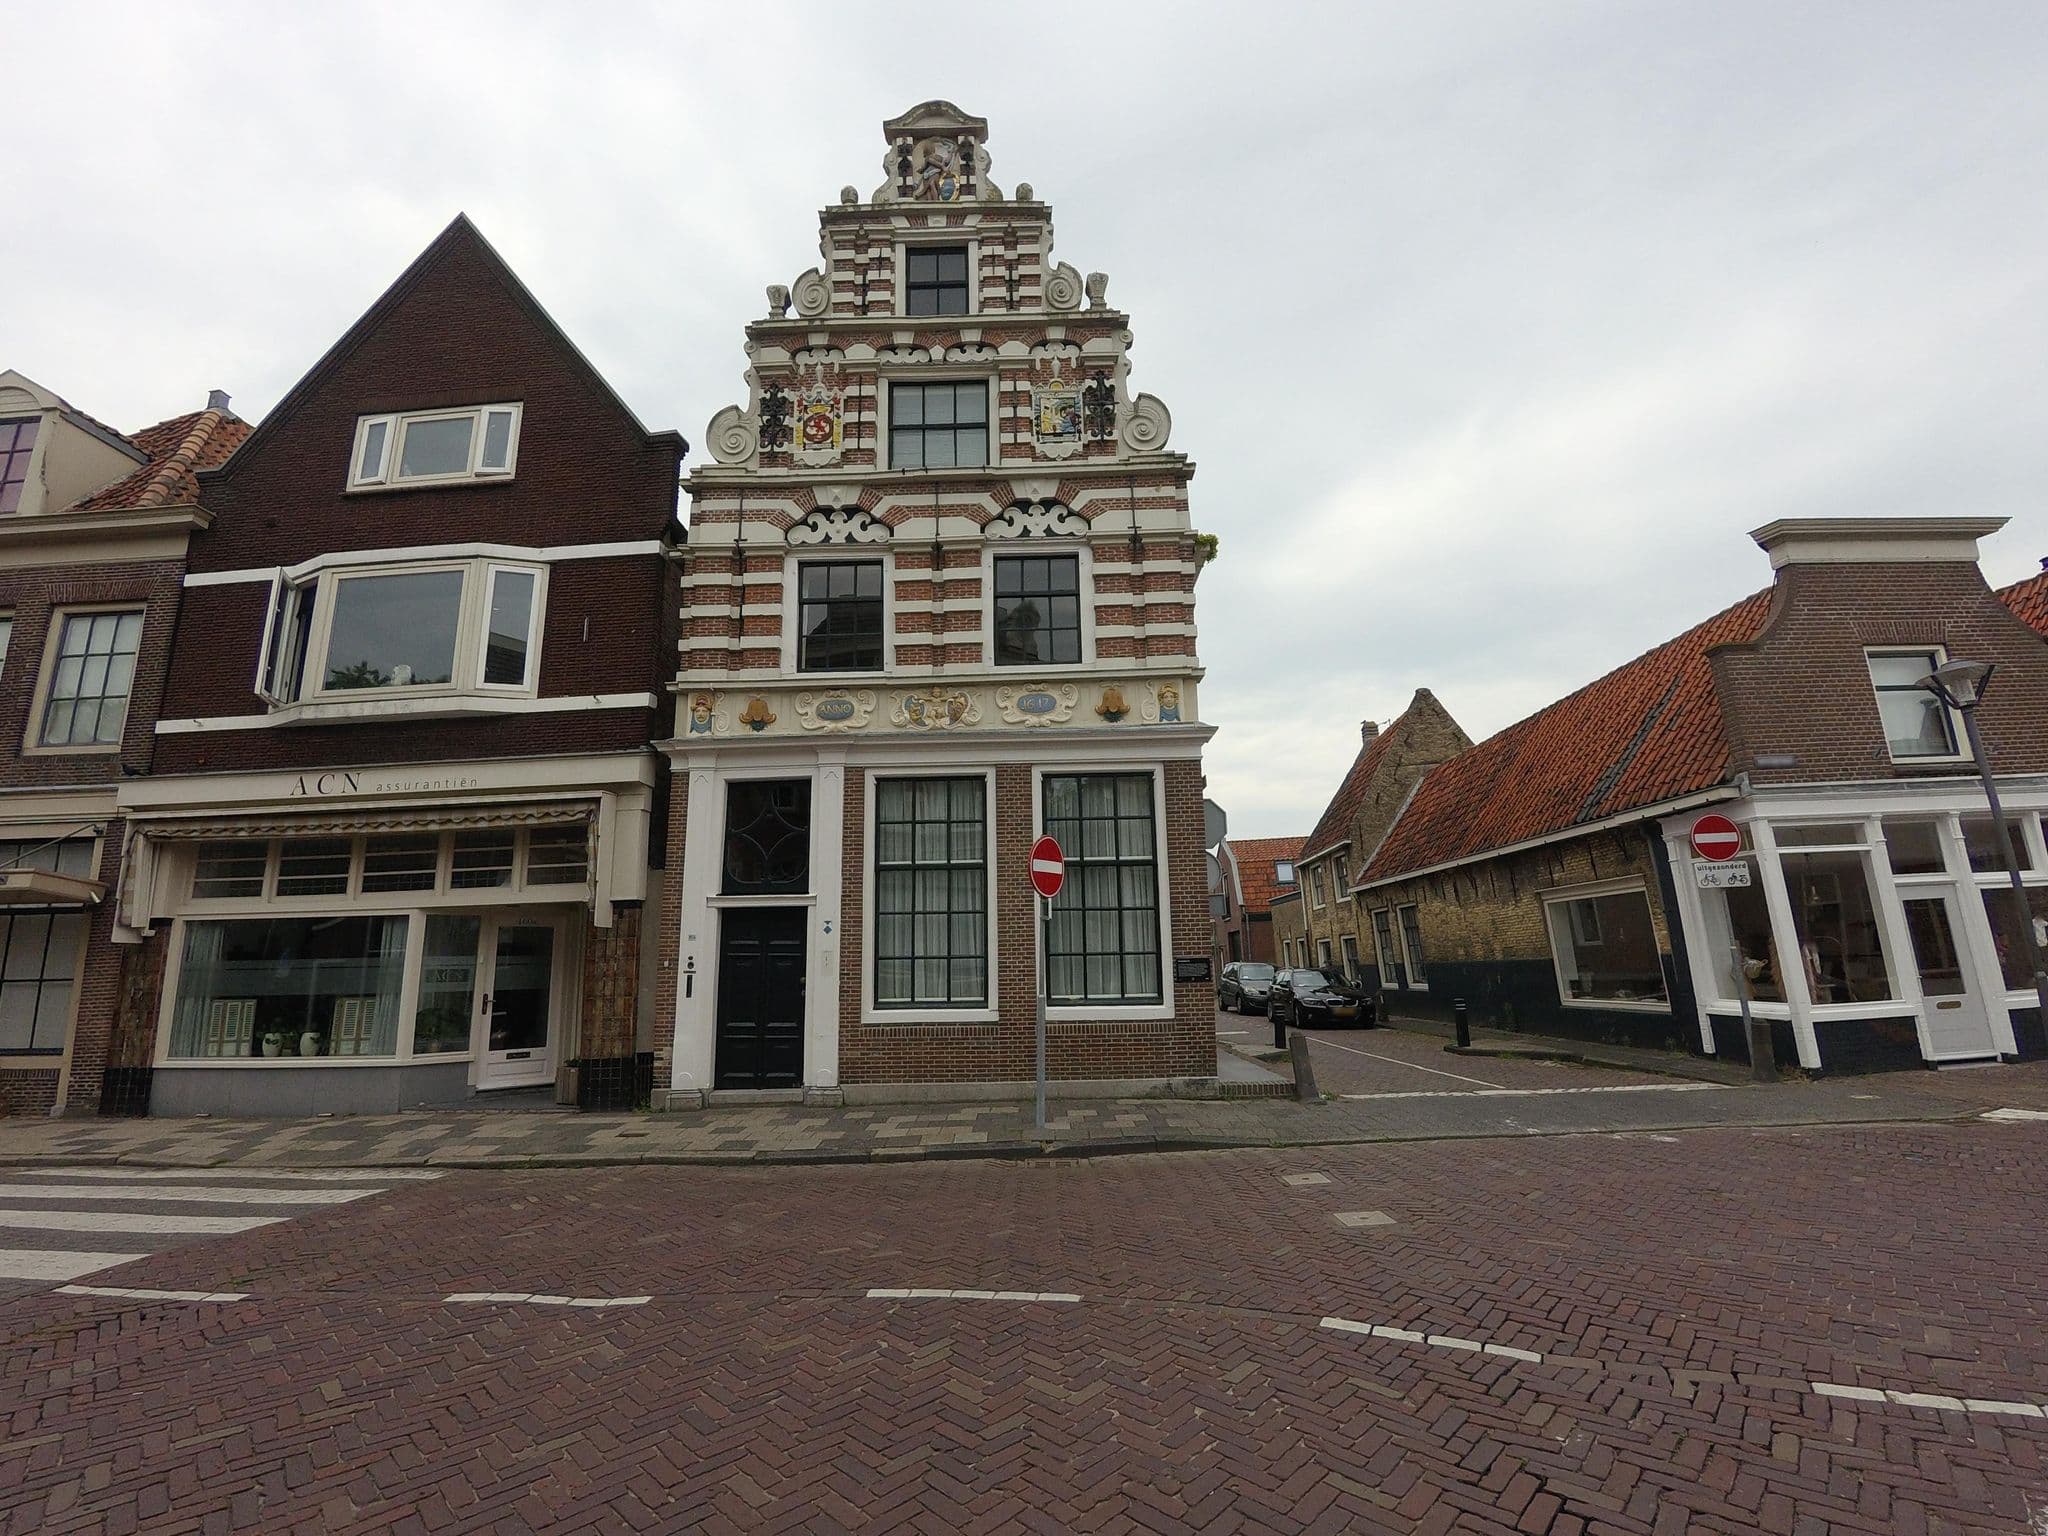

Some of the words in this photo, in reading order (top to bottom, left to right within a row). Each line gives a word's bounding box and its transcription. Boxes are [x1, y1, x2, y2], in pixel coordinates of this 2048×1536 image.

[820, 704, 851, 713] ANNO
[290, 772, 361, 796] ACN
[376, 777, 478, 792] assurantiën
[1697, 863, 1746, 872] uitgezonderd
